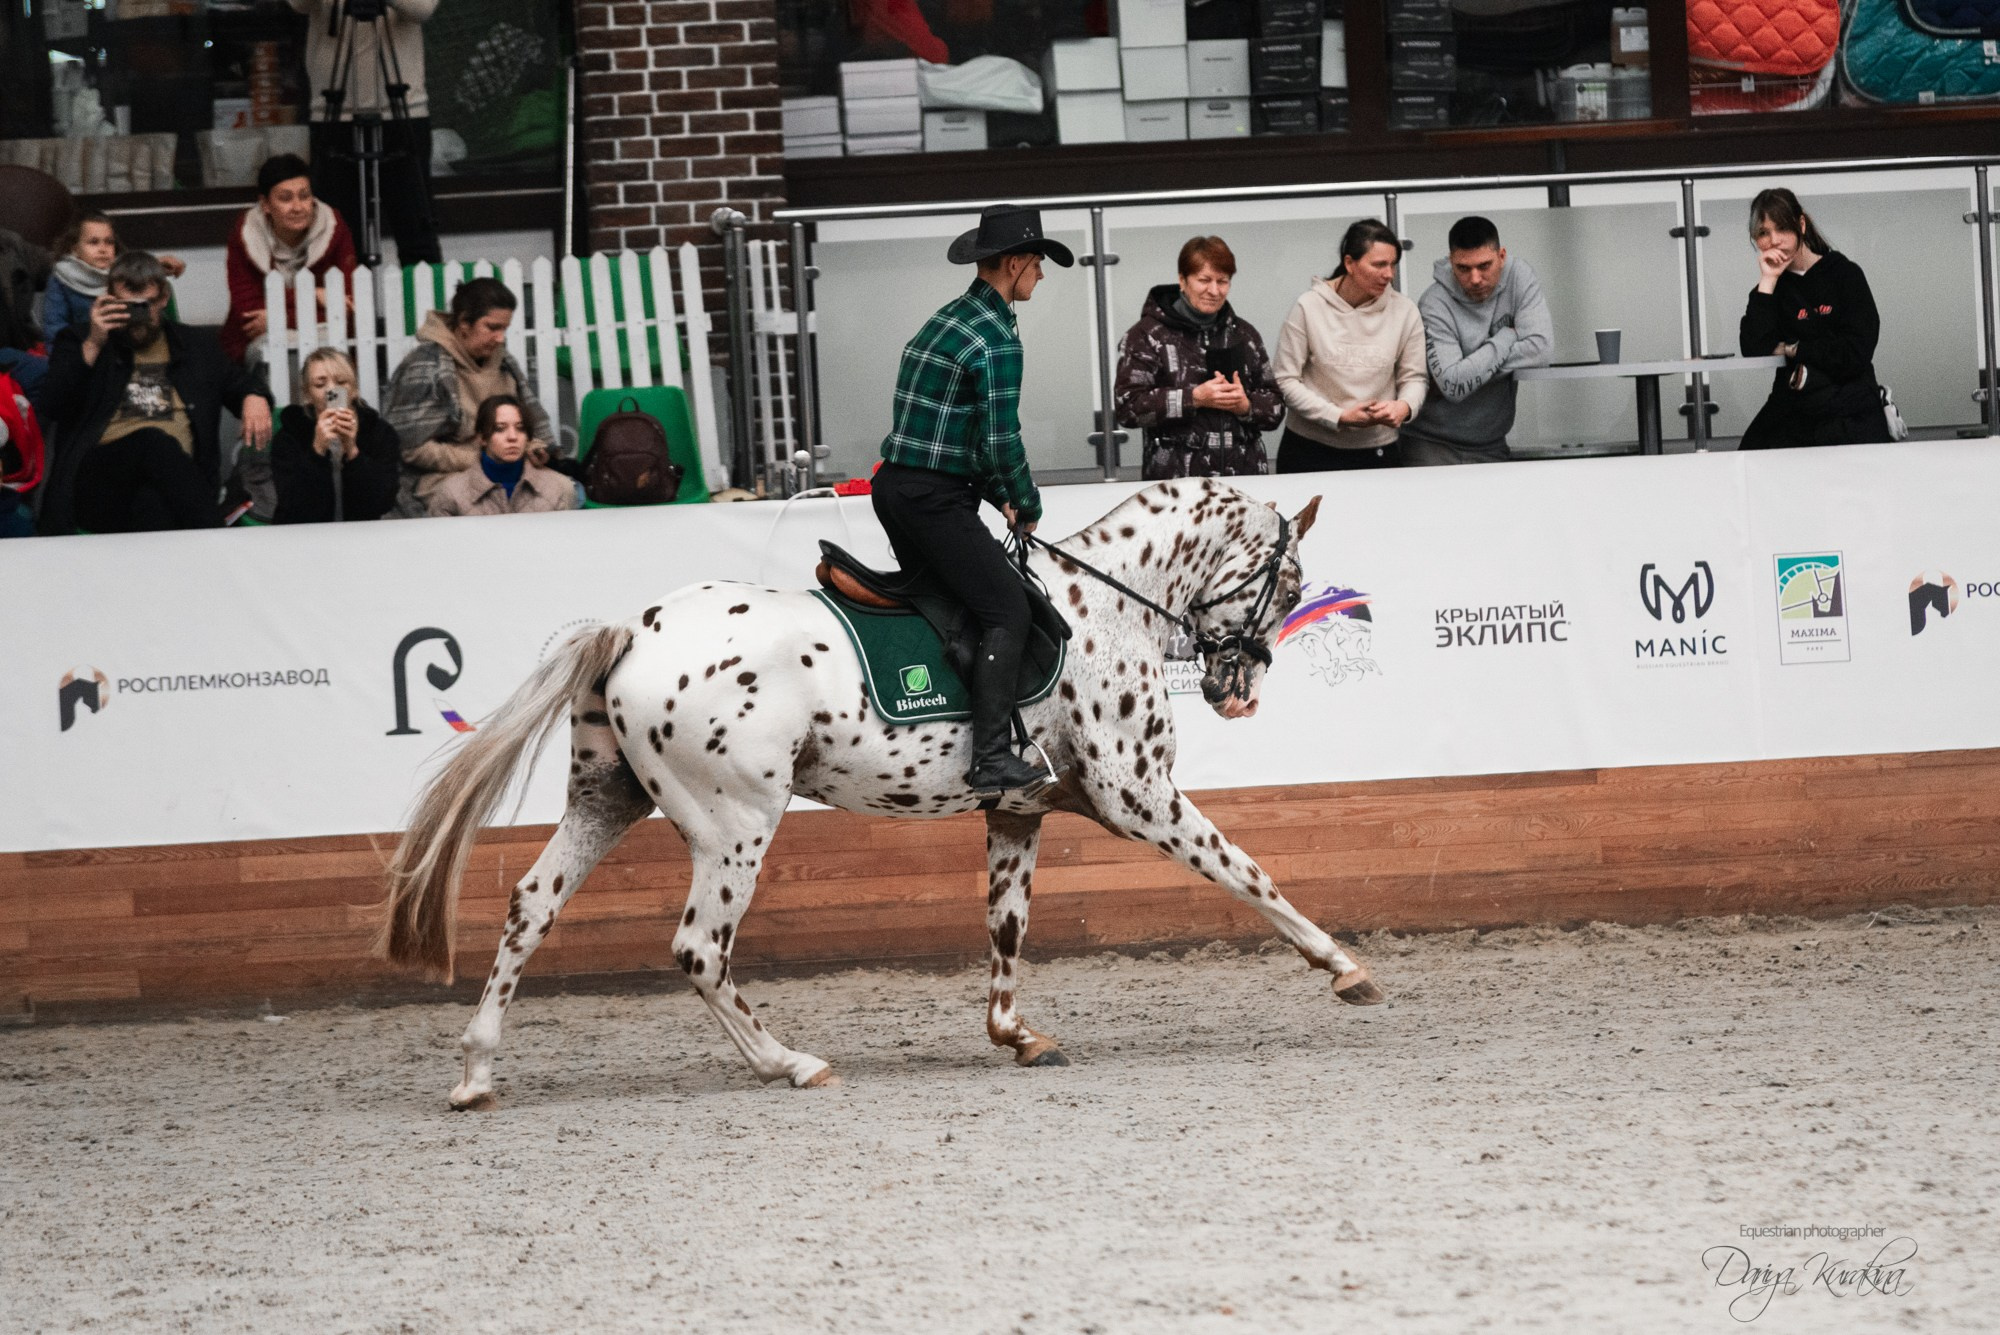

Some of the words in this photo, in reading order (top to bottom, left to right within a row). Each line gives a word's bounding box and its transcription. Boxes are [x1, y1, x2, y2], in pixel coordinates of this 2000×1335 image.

[1443, 376, 1482, 397] GAMES
[1435, 600, 1564, 624] КРЫЛАТЫЙ
[1435, 620, 1568, 647] ЭКЛИПС
[1791, 628, 1837, 638] MAXIMA
[118, 668, 331, 694] РОСПЛЕМКОНЗАВОД
[896, 693, 947, 712] Biotech
